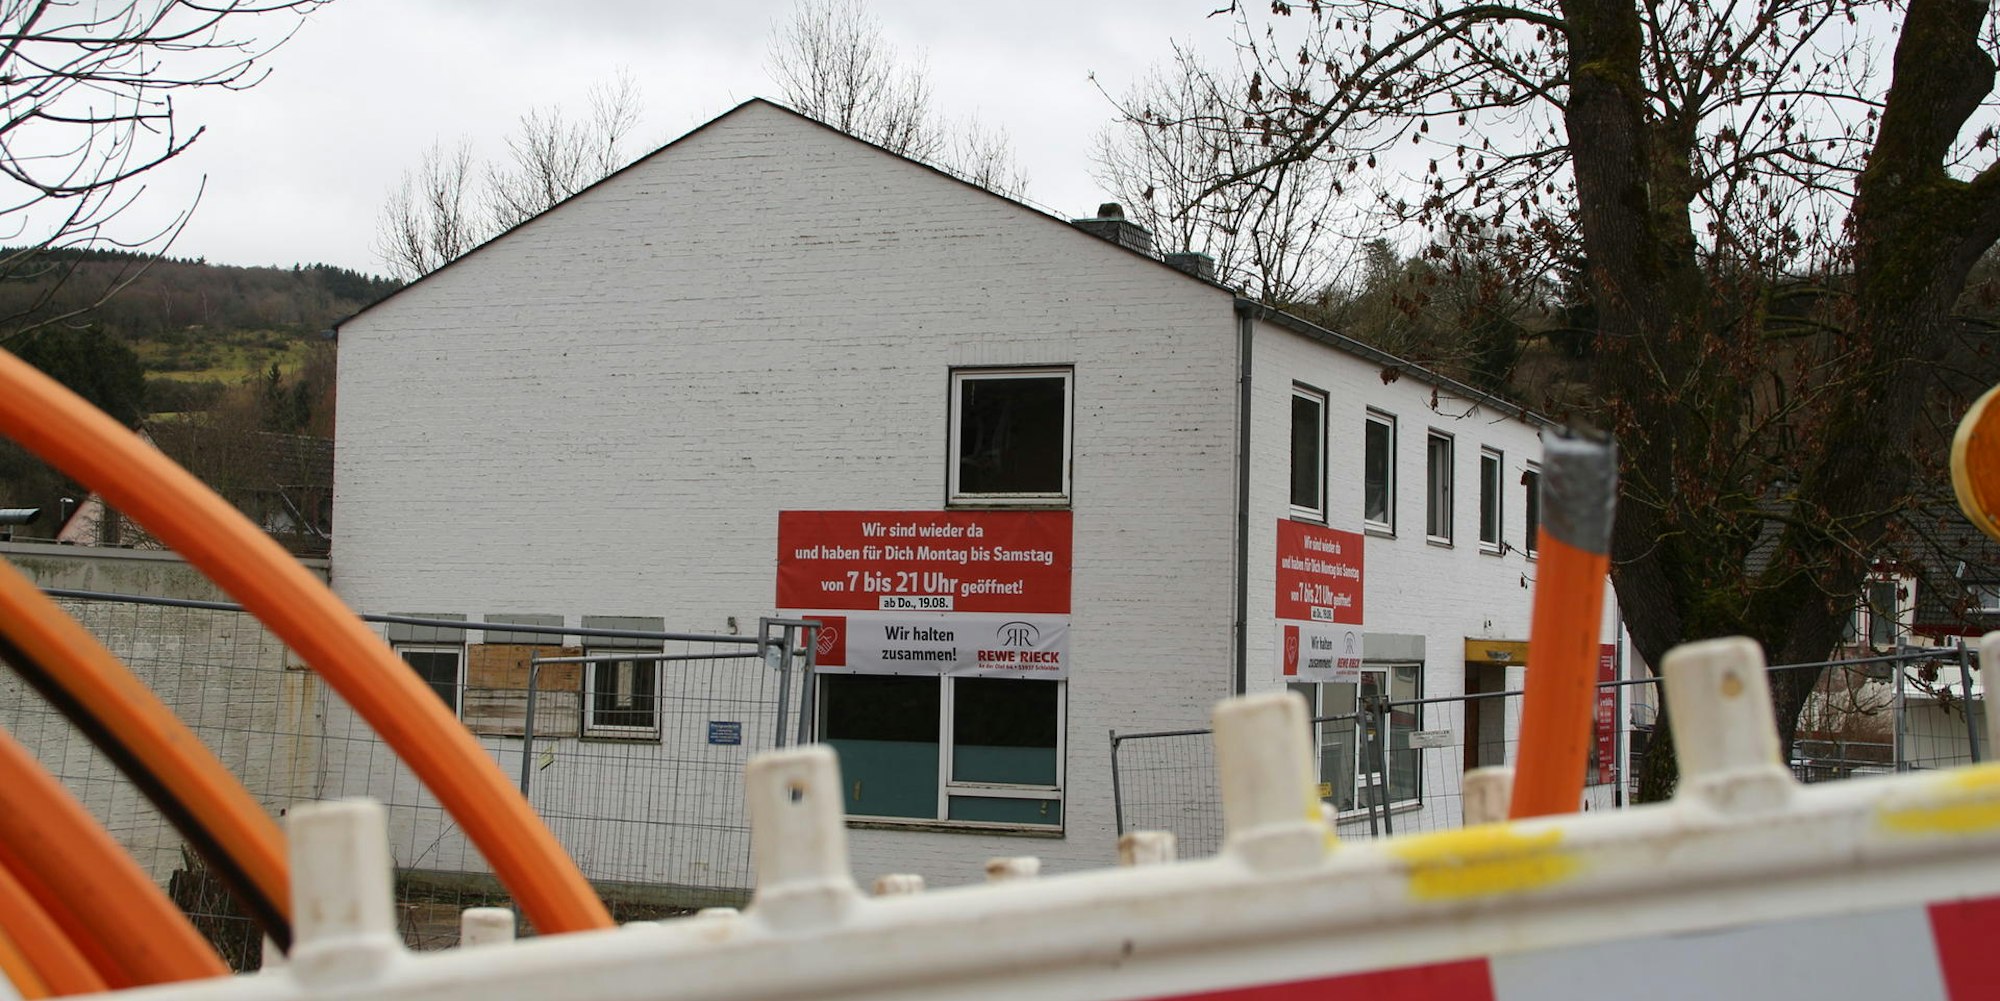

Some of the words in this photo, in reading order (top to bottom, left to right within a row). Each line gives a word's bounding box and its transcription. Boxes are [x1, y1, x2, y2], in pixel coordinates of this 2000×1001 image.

[862, 523, 887, 537] Wir
[890, 523, 916, 537] sind
[919, 524, 964, 537] wieder
[967, 524, 983, 538] da
[796, 546, 819, 559] und
[822, 546, 860, 559] haben
[863, 547, 882, 560] für
[885, 546, 913, 560] Dich
[917, 547, 967, 565] Montag
[971, 547, 990, 561] bis
[993, 547, 1053, 565] Samstag
[821, 581, 843, 591] von
[847, 572, 857, 592] 7
[863, 572, 892, 592] bis
[896, 572, 918, 592] 21
[924, 573, 958, 593] Uhr
[961, 580, 1023, 597] geöffnet!
[1299, 582, 1304, 602] 7
[1304, 583, 1313, 603] bis
[1315, 584, 1322, 603] 21
[1323, 585, 1333, 604] Uhr
[884, 598, 895, 608] ab
[898, 598, 916, 609] Do.,
[919, 598, 948, 608] 19.08.
[886, 626, 910, 640] Wir
[913, 627, 954, 641] halten
[882, 647, 957, 660] zusammen!
[978, 650, 1015, 662] REWE
[1021, 652, 1060, 663] RIECK
